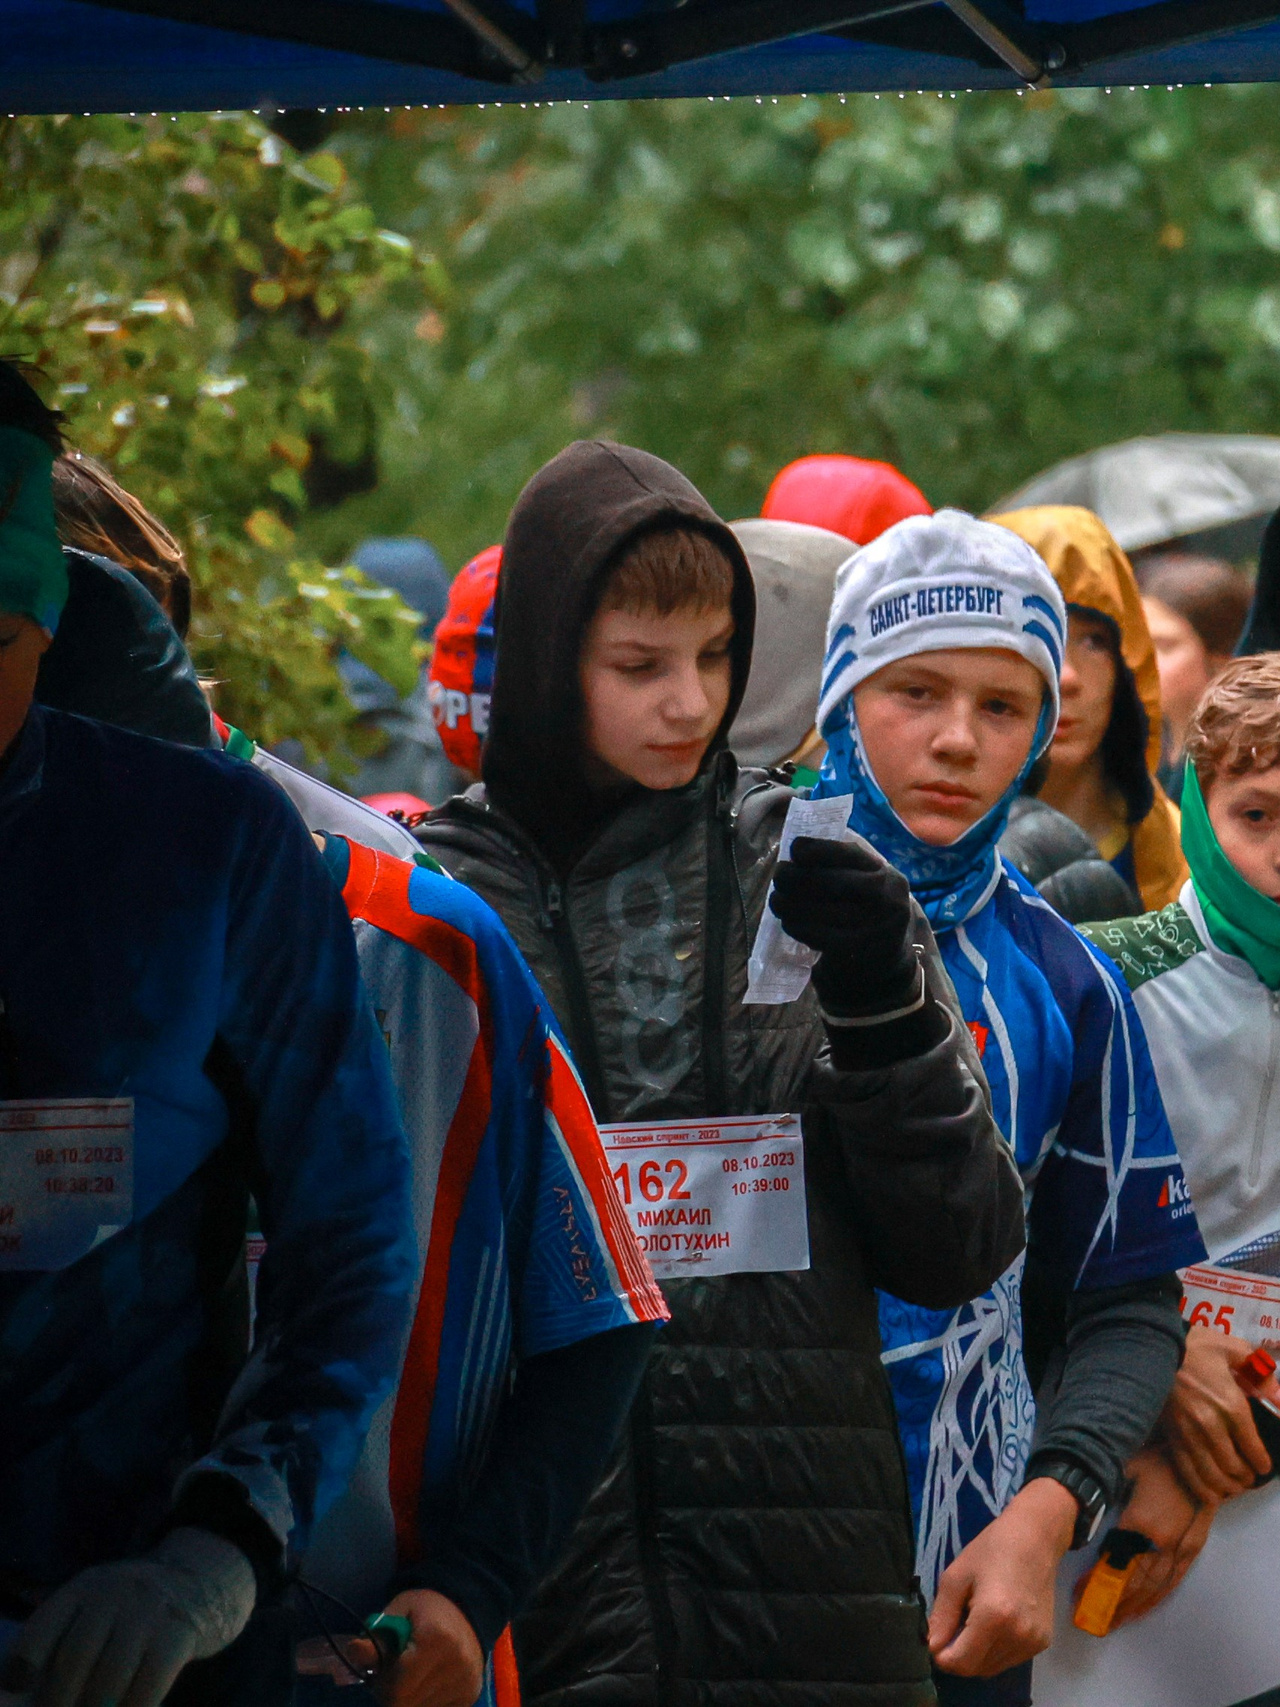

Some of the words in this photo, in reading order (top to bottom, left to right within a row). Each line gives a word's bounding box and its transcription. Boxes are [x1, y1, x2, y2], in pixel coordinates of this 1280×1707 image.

[870, 584, 1003, 637] САНКТ-ПЕТЕРБУРГ
[698, 1129, 720, 1140] 2023
[613, 1158, 691, 1204] 162
[722, 1152, 796, 1173] 08.10.2023
[731, 1177, 790, 1196] 10:39:00
[637, 1208, 712, 1228] МИХАИЛ
[636, 1231, 731, 1253] ОЛОТУХИН
